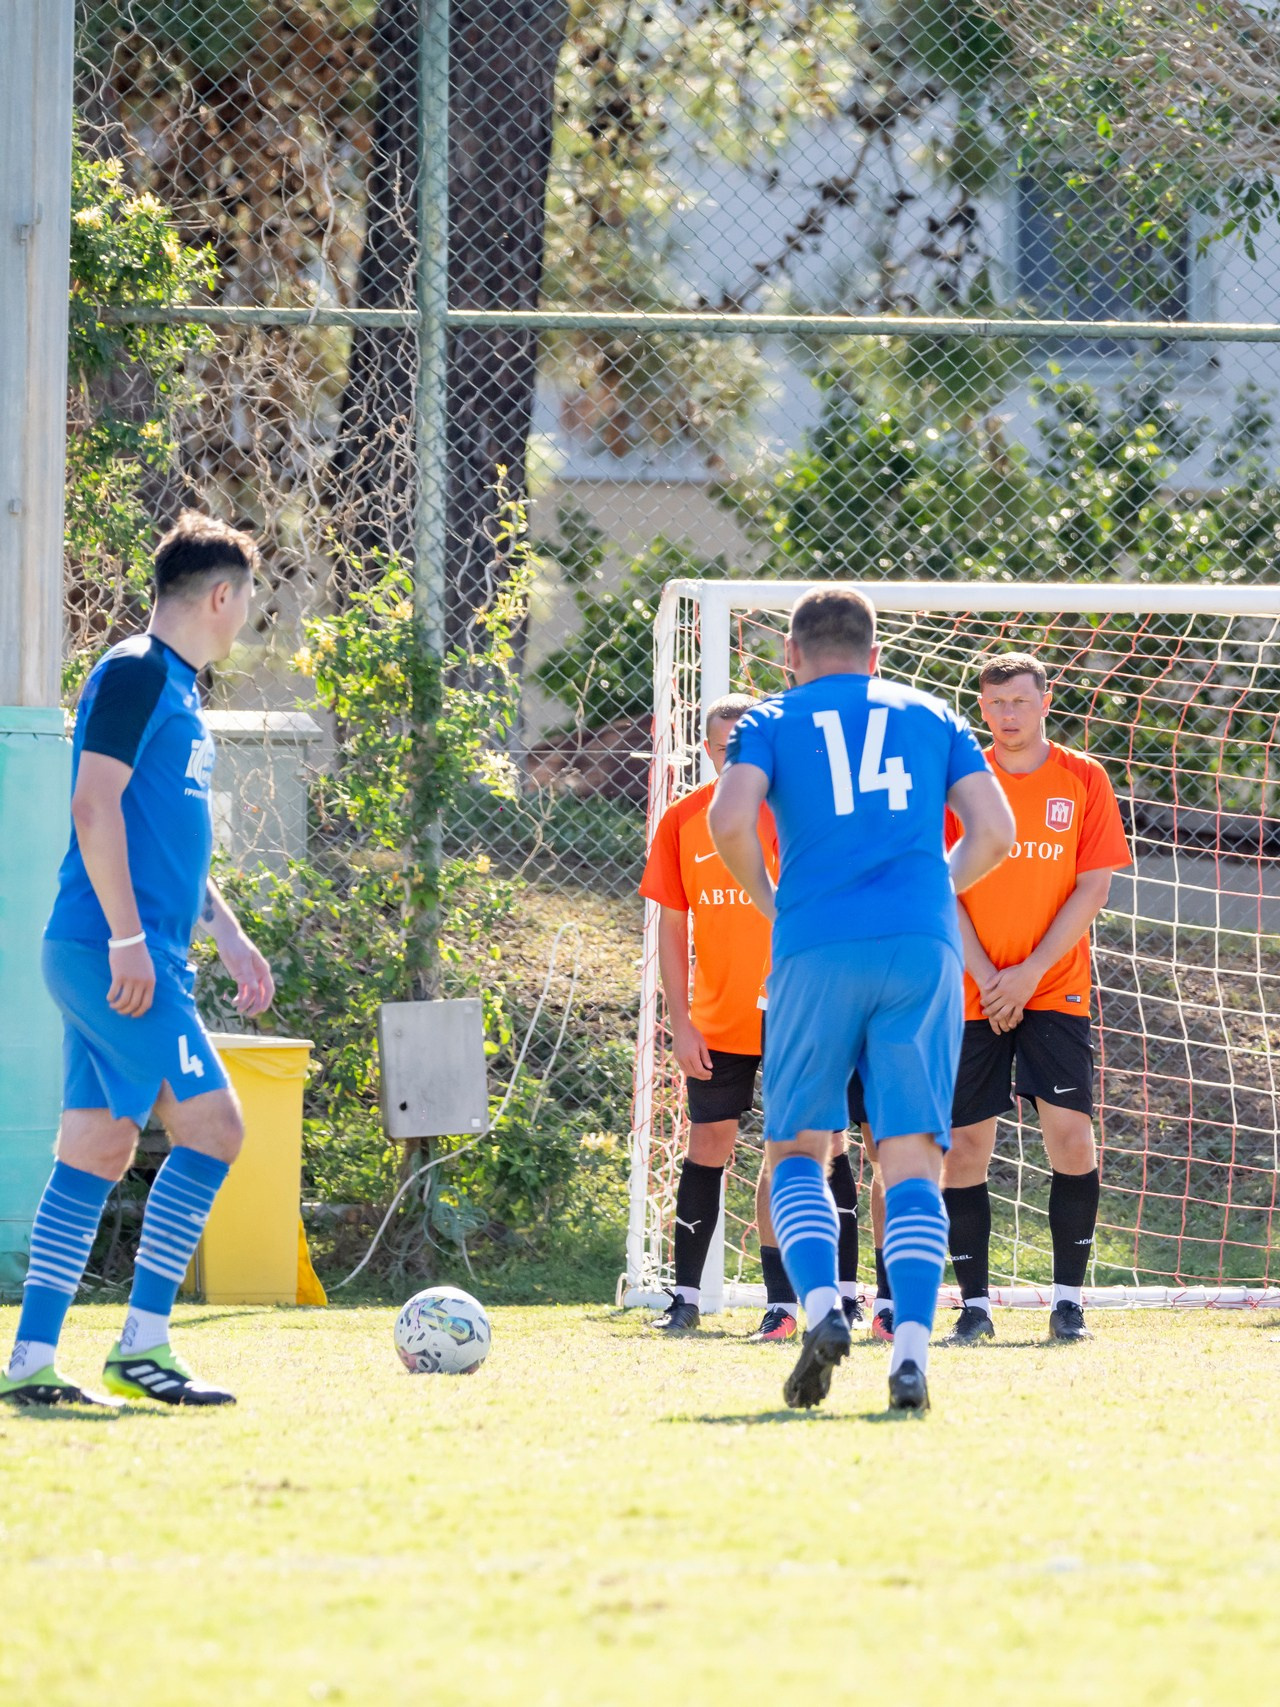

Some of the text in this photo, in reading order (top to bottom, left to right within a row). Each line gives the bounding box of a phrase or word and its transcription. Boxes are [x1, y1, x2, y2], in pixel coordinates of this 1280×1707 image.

[812, 707, 913, 816] 14
[1008, 841, 1064, 861] ОТОР
[698, 888, 753, 905] АВТО
[178, 1034, 205, 1078] 4
